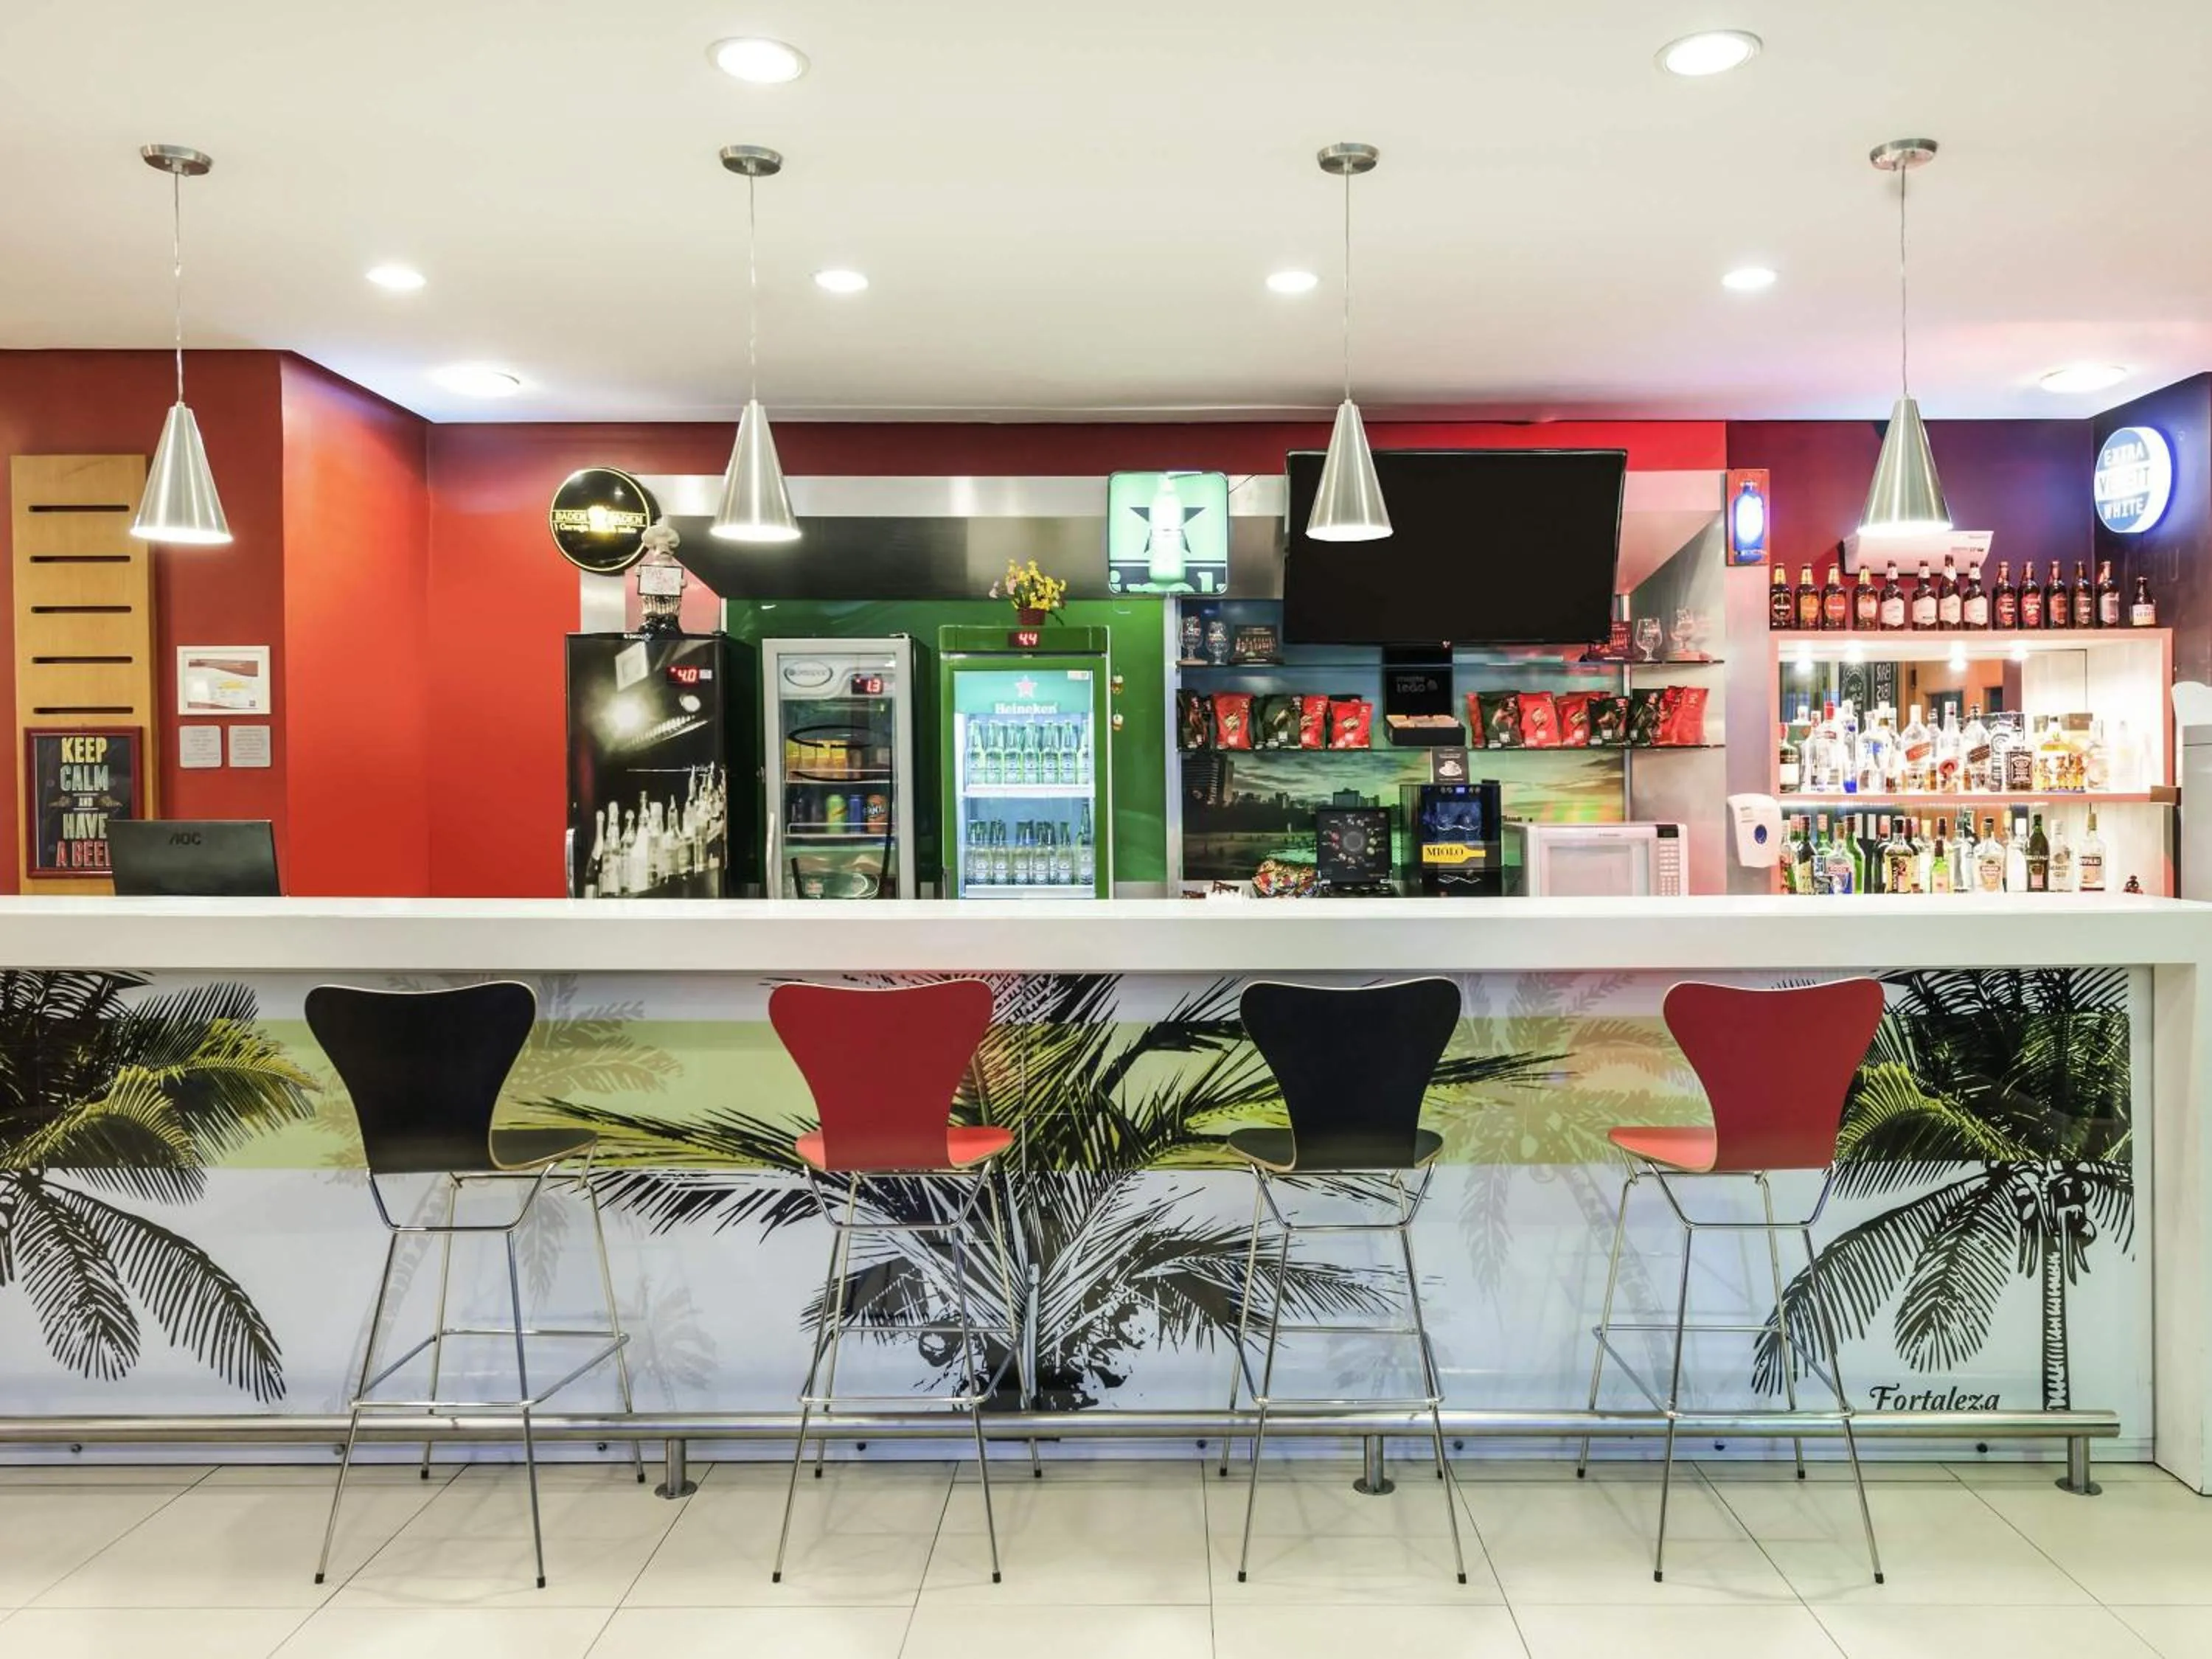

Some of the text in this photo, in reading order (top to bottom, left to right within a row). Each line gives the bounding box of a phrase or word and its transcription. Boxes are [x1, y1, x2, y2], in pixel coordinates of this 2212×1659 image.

[2098, 467, 2151, 496] VTT
[2104, 498, 2145, 520] WHITE
[1109, 570, 1228, 593] ik
[995, 703, 1057, 714] Heineken
[61, 737, 107, 763] KEEP
[60, 765, 109, 791] CALM
[78, 797, 94, 807] AND
[63, 813, 108, 839] HAVE
[169, 832, 201, 846] AOC
[56, 841, 68, 866] A
[1427, 847, 1464, 856] MIOLO
[1869, 1382, 2000, 1411] Fortaleza
